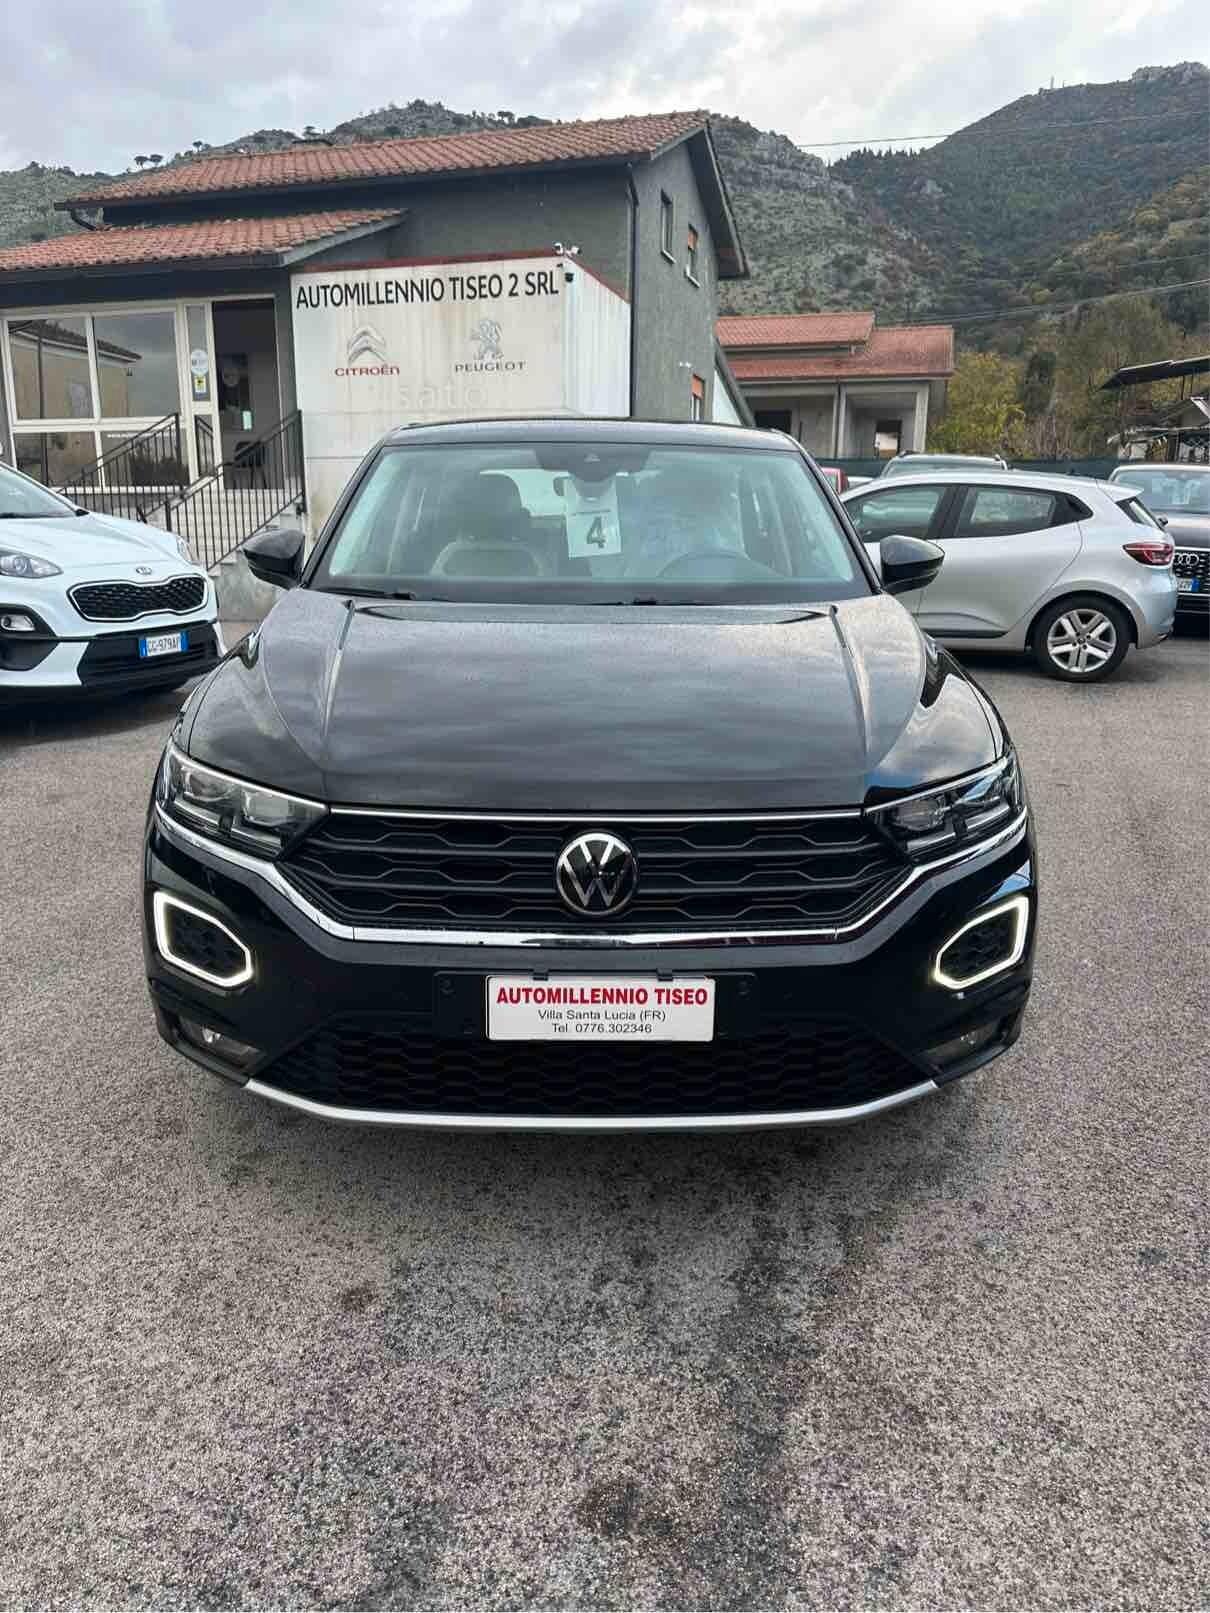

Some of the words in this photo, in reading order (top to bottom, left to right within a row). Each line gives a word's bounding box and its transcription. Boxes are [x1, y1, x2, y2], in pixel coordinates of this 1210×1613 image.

[296, 277, 445, 309] AUTOMILLENNIO
[448, 274, 503, 301] TISEO
[508, 273, 519, 297] 2
[524, 271, 559, 296] SRL
[454, 361, 527, 373] PEUGEOT
[586, 516, 606, 549] 4
[496, 987, 648, 1005] AUTOMILLENNIO
[655, 988, 709, 1005] TISEO
[538, 1009, 563, 1020] Villa
[566, 1009, 601, 1020] Santa
[604, 1009, 637, 1020] Lucia
[639, 1008, 667, 1022] (FR)
[575, 1023, 653, 1033] 0776.302346
